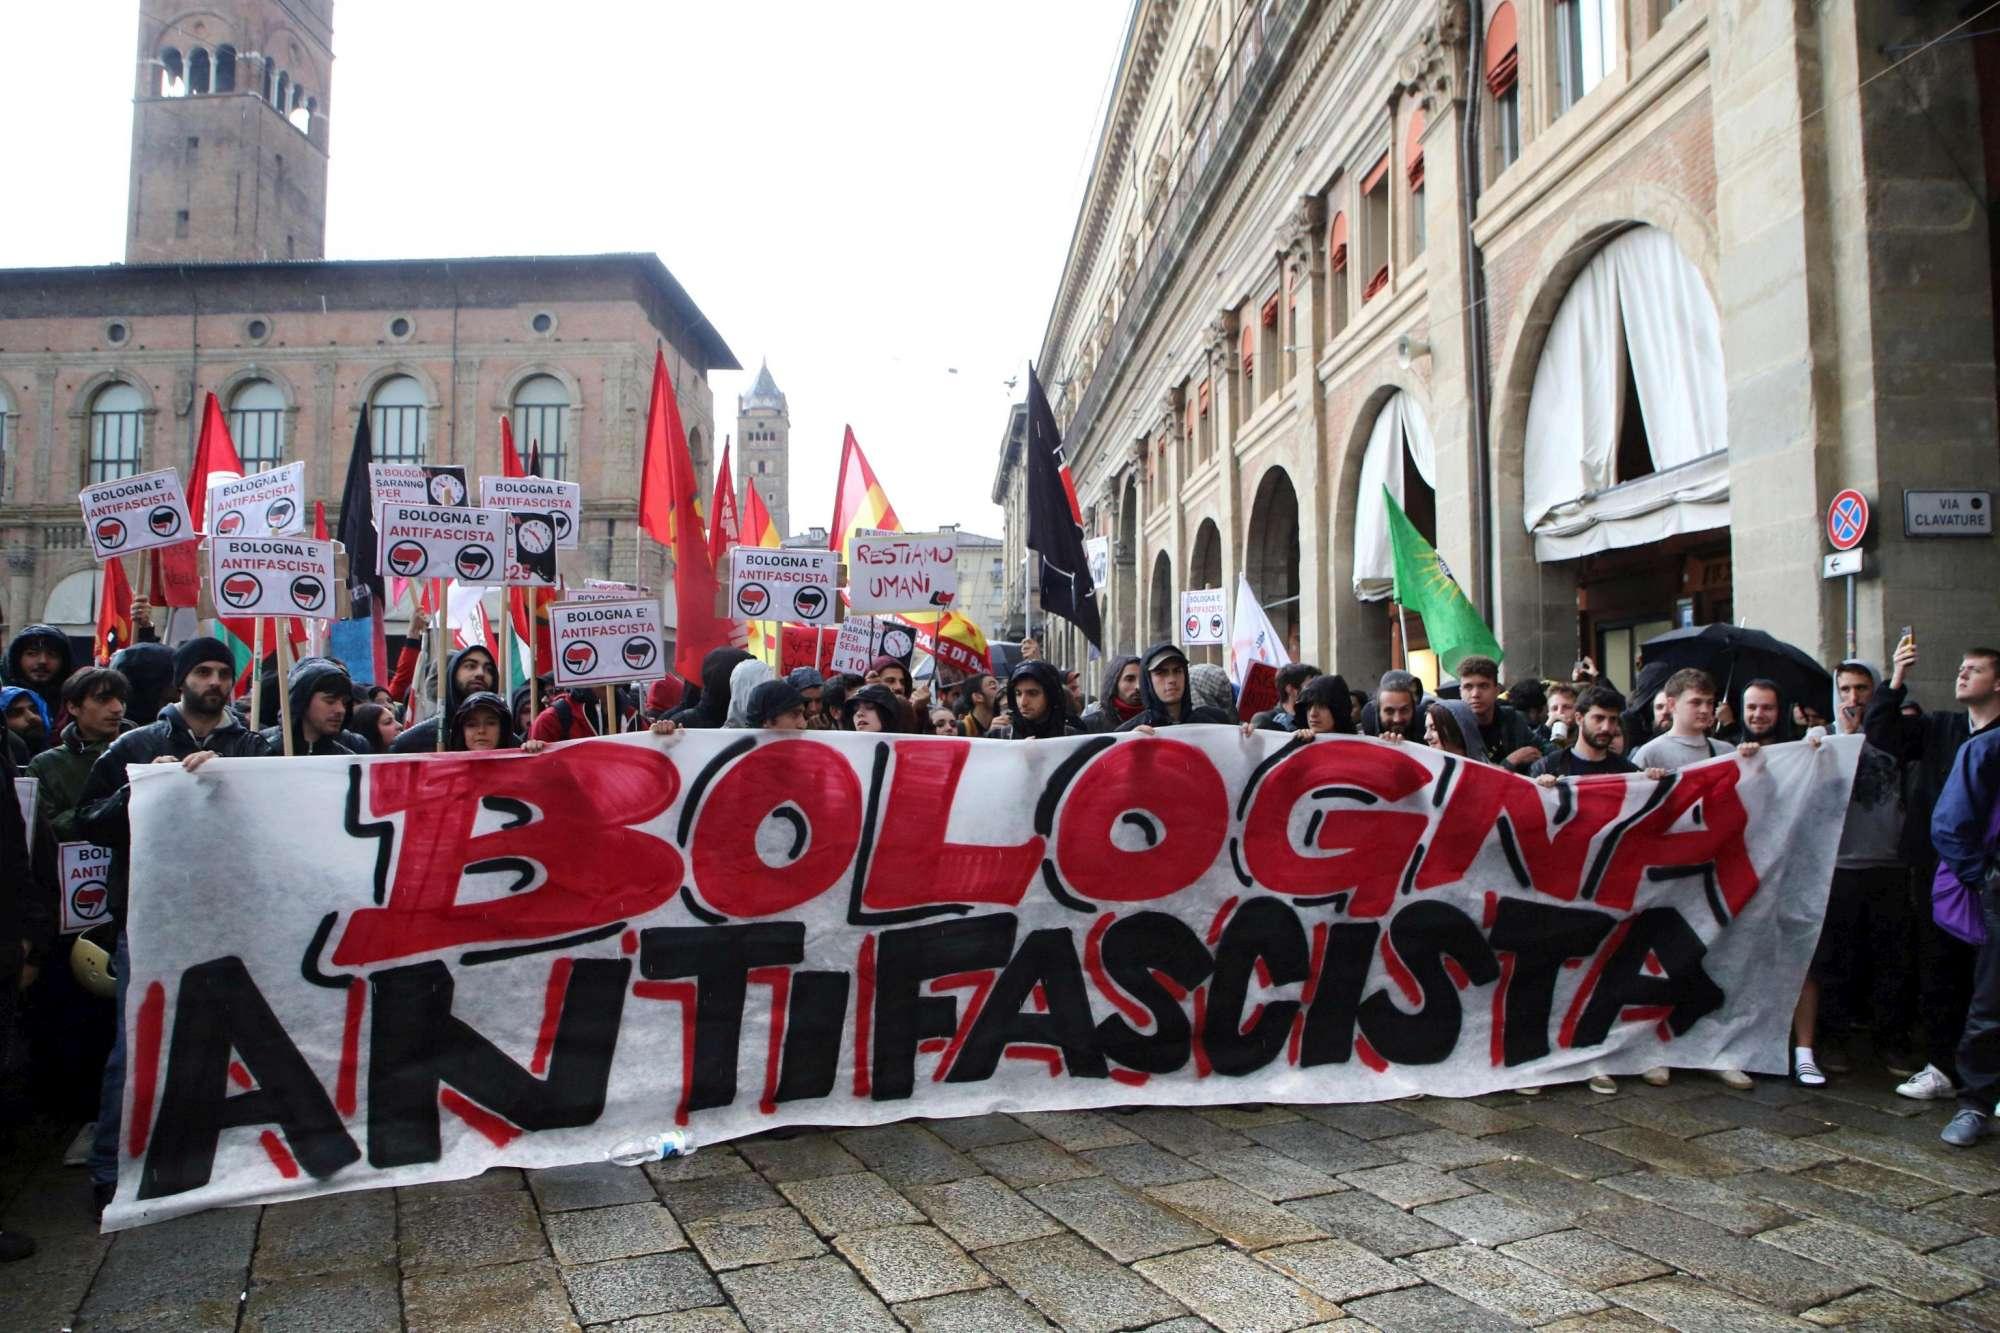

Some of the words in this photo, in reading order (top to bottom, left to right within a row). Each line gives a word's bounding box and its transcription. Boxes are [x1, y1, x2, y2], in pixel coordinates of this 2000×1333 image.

[384, 469, 432, 478] BOLOGNA
[92, 482, 152, 503] BOLOGNA
[154, 479, 165, 489] E'
[224, 475, 278, 496] BOLOGNA
[376, 480, 424, 488] SARANNO
[495, 483, 553, 495] BOLOGNA
[557, 486, 566, 495] E'
[217, 483, 296, 511] ANTIFASCISTA
[378, 489, 401, 497] PER
[90, 492, 176, 518] ANTIFASCISTA
[488, 496, 572, 508] ANTIFASCISTA
[1940, 498, 1959, 509] VIA
[399, 509, 472, 525] BOLOGNA
[476, 514, 488, 525] E'
[1915, 514, 1985, 526] CLAVATURE
[389, 526, 495, 542] ANTIFASCISTA
[229, 542, 304, 556] BOLOGNA
[308, 547, 318, 557] E'
[221, 559, 325, 574] ANTIFASCISTA
[746, 555, 808, 568] BOLOGNA
[812, 558, 824, 568] E'
[738, 570, 829, 583] ANTIFASCISTA
[567, 609, 633, 623] BOLOGNA
[636, 607, 647, 618] E'
[561, 622, 655, 639] ANTIFASCISTA
[841, 632, 858, 642] PER
[951, 646, 968, 663] DI
[316, 737, 1759, 970] BOLOGNA
[71, 864, 111, 880] ANTI
[132, 896, 1725, 1200] ANTIFASCISTA
